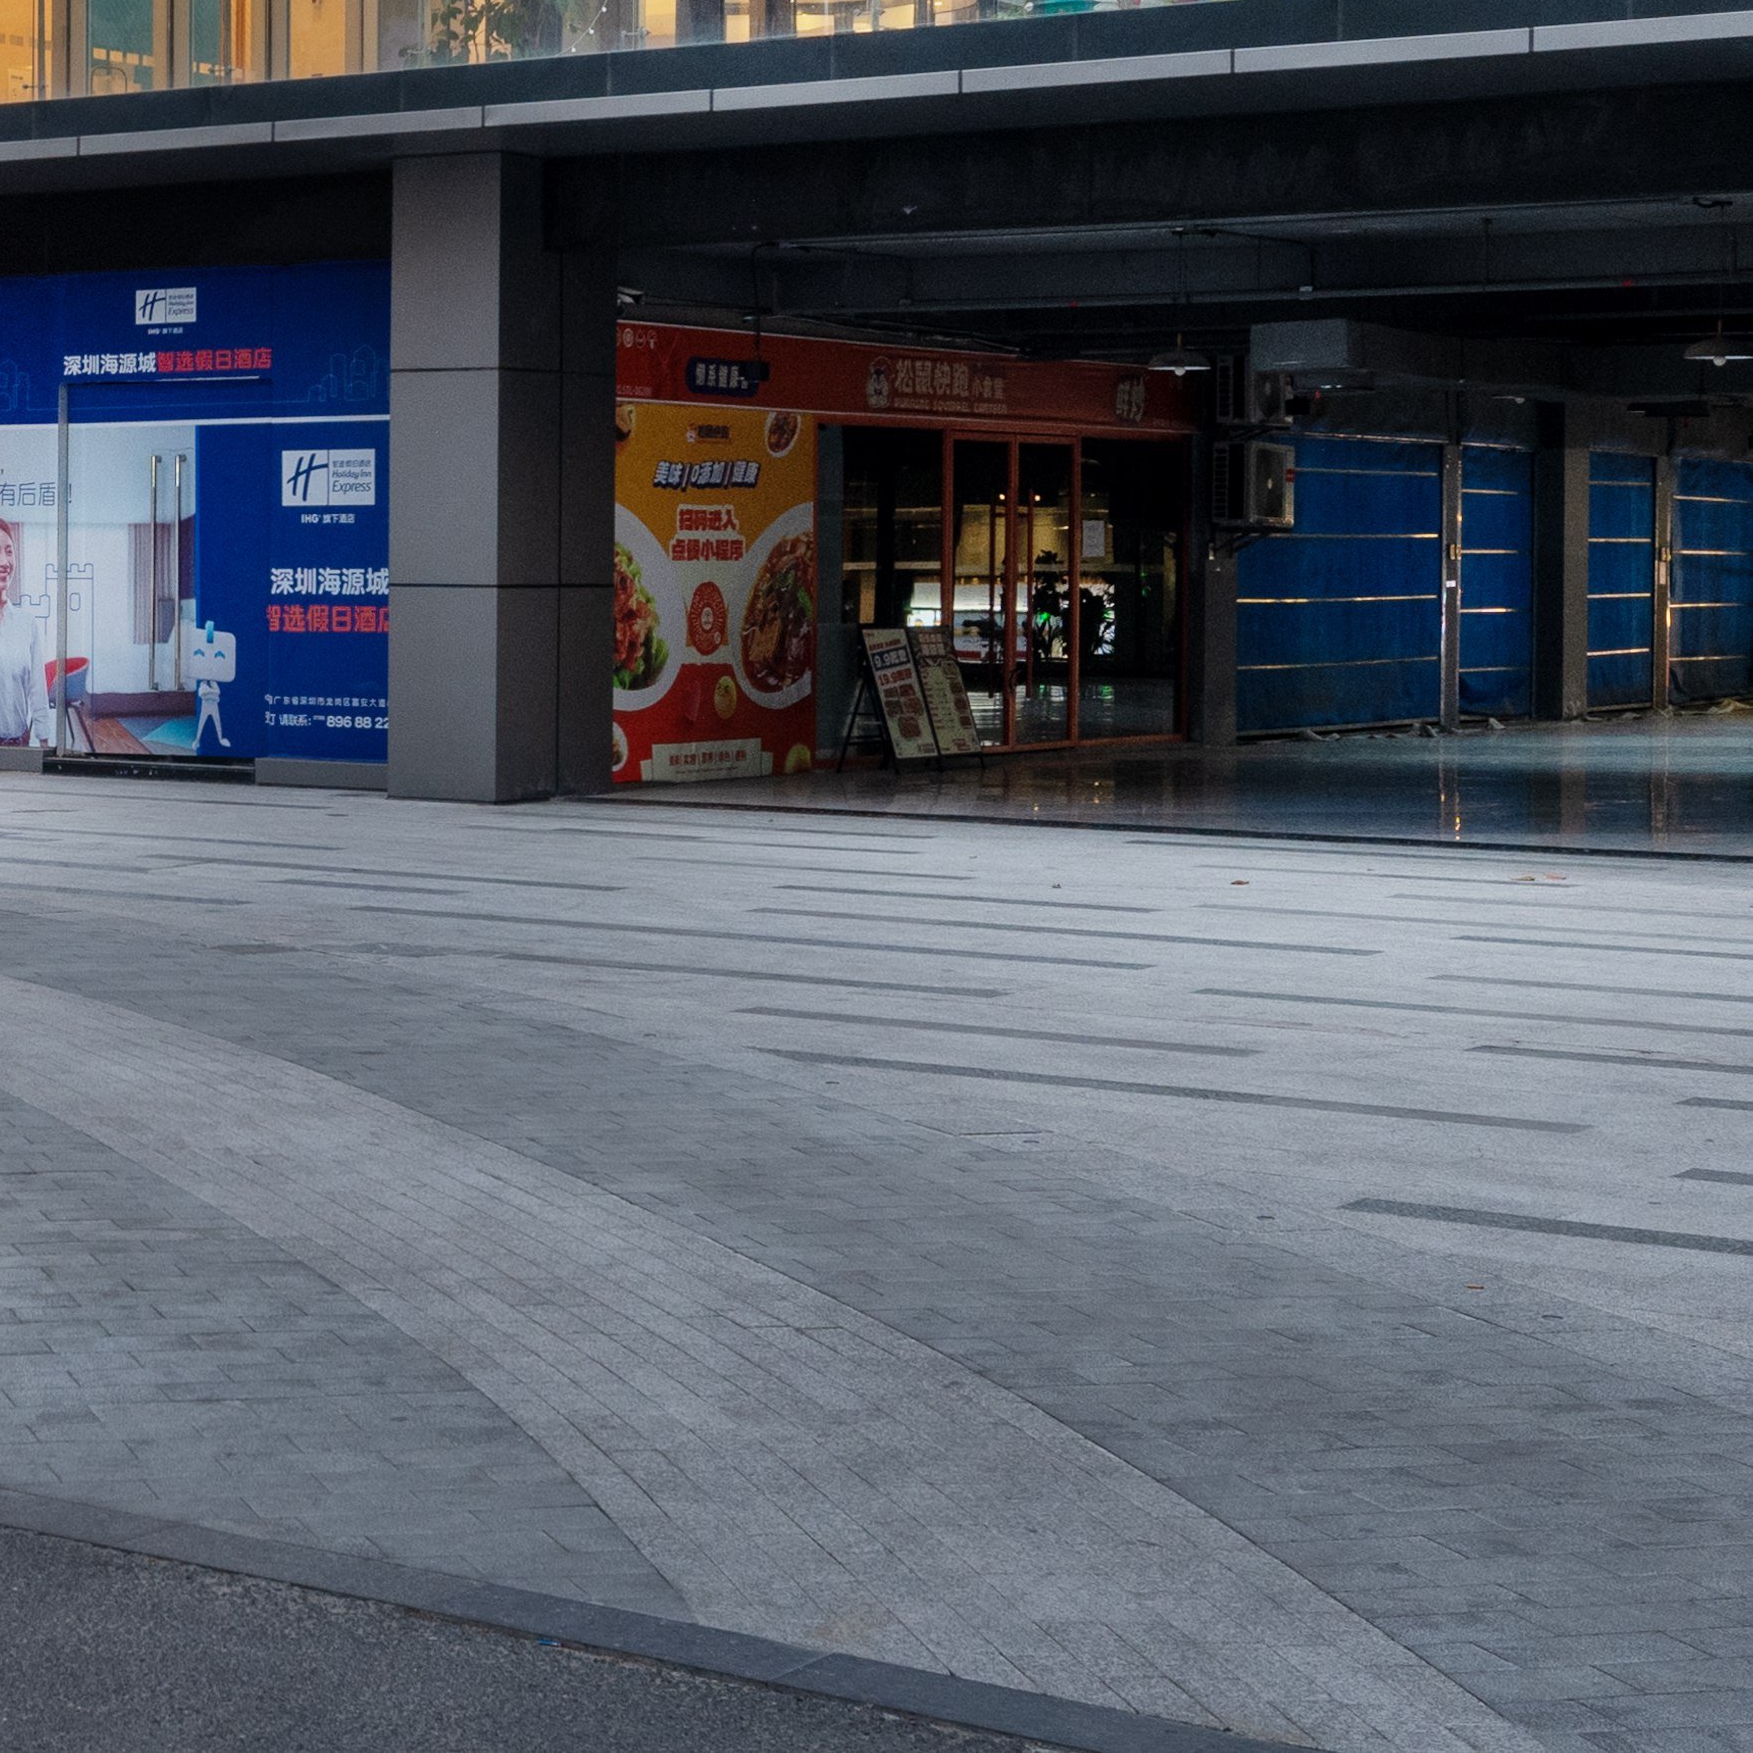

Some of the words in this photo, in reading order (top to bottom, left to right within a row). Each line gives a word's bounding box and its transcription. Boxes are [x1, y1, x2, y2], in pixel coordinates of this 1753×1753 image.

[63, 346, 273, 376] 深圳海源城智选假日酒店
[332, 469, 360, 480] Holiday
[360, 469, 372, 478] Inn
[332, 480, 372, 496] Express
[678, 508, 737, 532] 扫码进入
[671, 538, 744, 561] 点餐小程序
[270, 566, 389, 595] 深圳海源城
[326, 715, 352, 728] 896
[354, 716, 372, 729] 88
